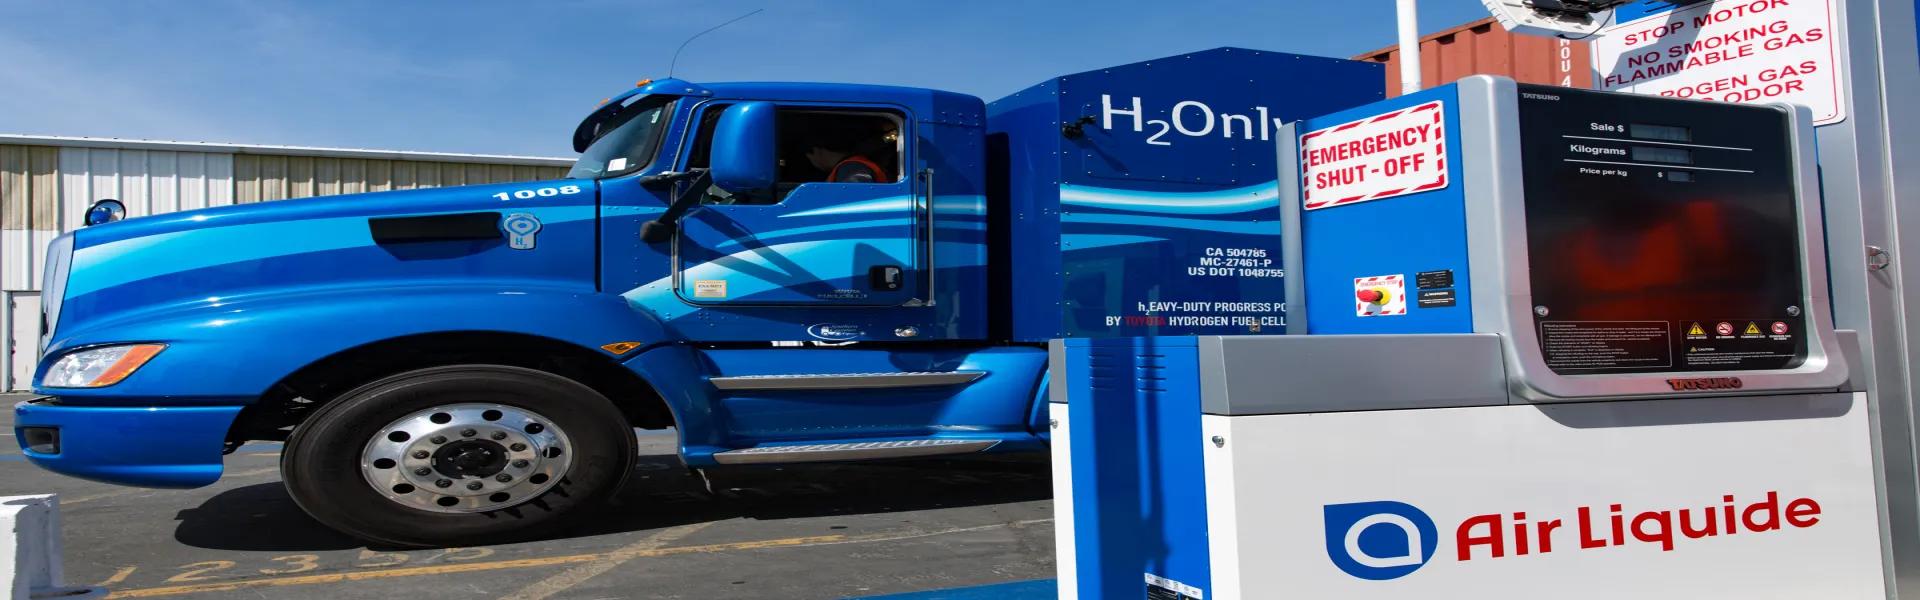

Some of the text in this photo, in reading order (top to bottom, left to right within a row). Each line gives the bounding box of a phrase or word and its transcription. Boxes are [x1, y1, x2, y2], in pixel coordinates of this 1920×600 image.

[1624, 0, 1789, 46] STOP MOTOR
[1627, 20, 1789, 68] NO SMOKING
[1604, 28, 1824, 88] FLAMMABLE GAS
[1652, 60, 1817, 98] ROGEN GAS
[1522, 92, 1560, 101] TATSUNO
[1724, 80, 1804, 103] ODOR
[1590, 122, 1625, 133] Sale $
[1309, 123, 1431, 167] EMERGENCY
[1570, 144, 1627, 156] Kilograms
[1316, 164, 1368, 190] SHUT
[1384, 152, 1425, 177] OFF
[1580, 167, 1601, 175] Price
[1603, 168, 1616, 176] per
[1618, 169, 1628, 177] kg
[492, 185, 581, 201] 1008
[1206, 247, 1267, 258] CA 504785
[1200, 257, 1272, 267] MC-27461-P
[1188, 267, 1284, 277] US DOT 1048755
[1214, 302, 1271, 313] PROGRESS
[1105, 316, 1287, 327] BY TOYOTA HYDROGEN FUEL CELL
[1667, 377, 1743, 391] TATSUNO
[1455, 491, 1822, 562] Air Liquide
